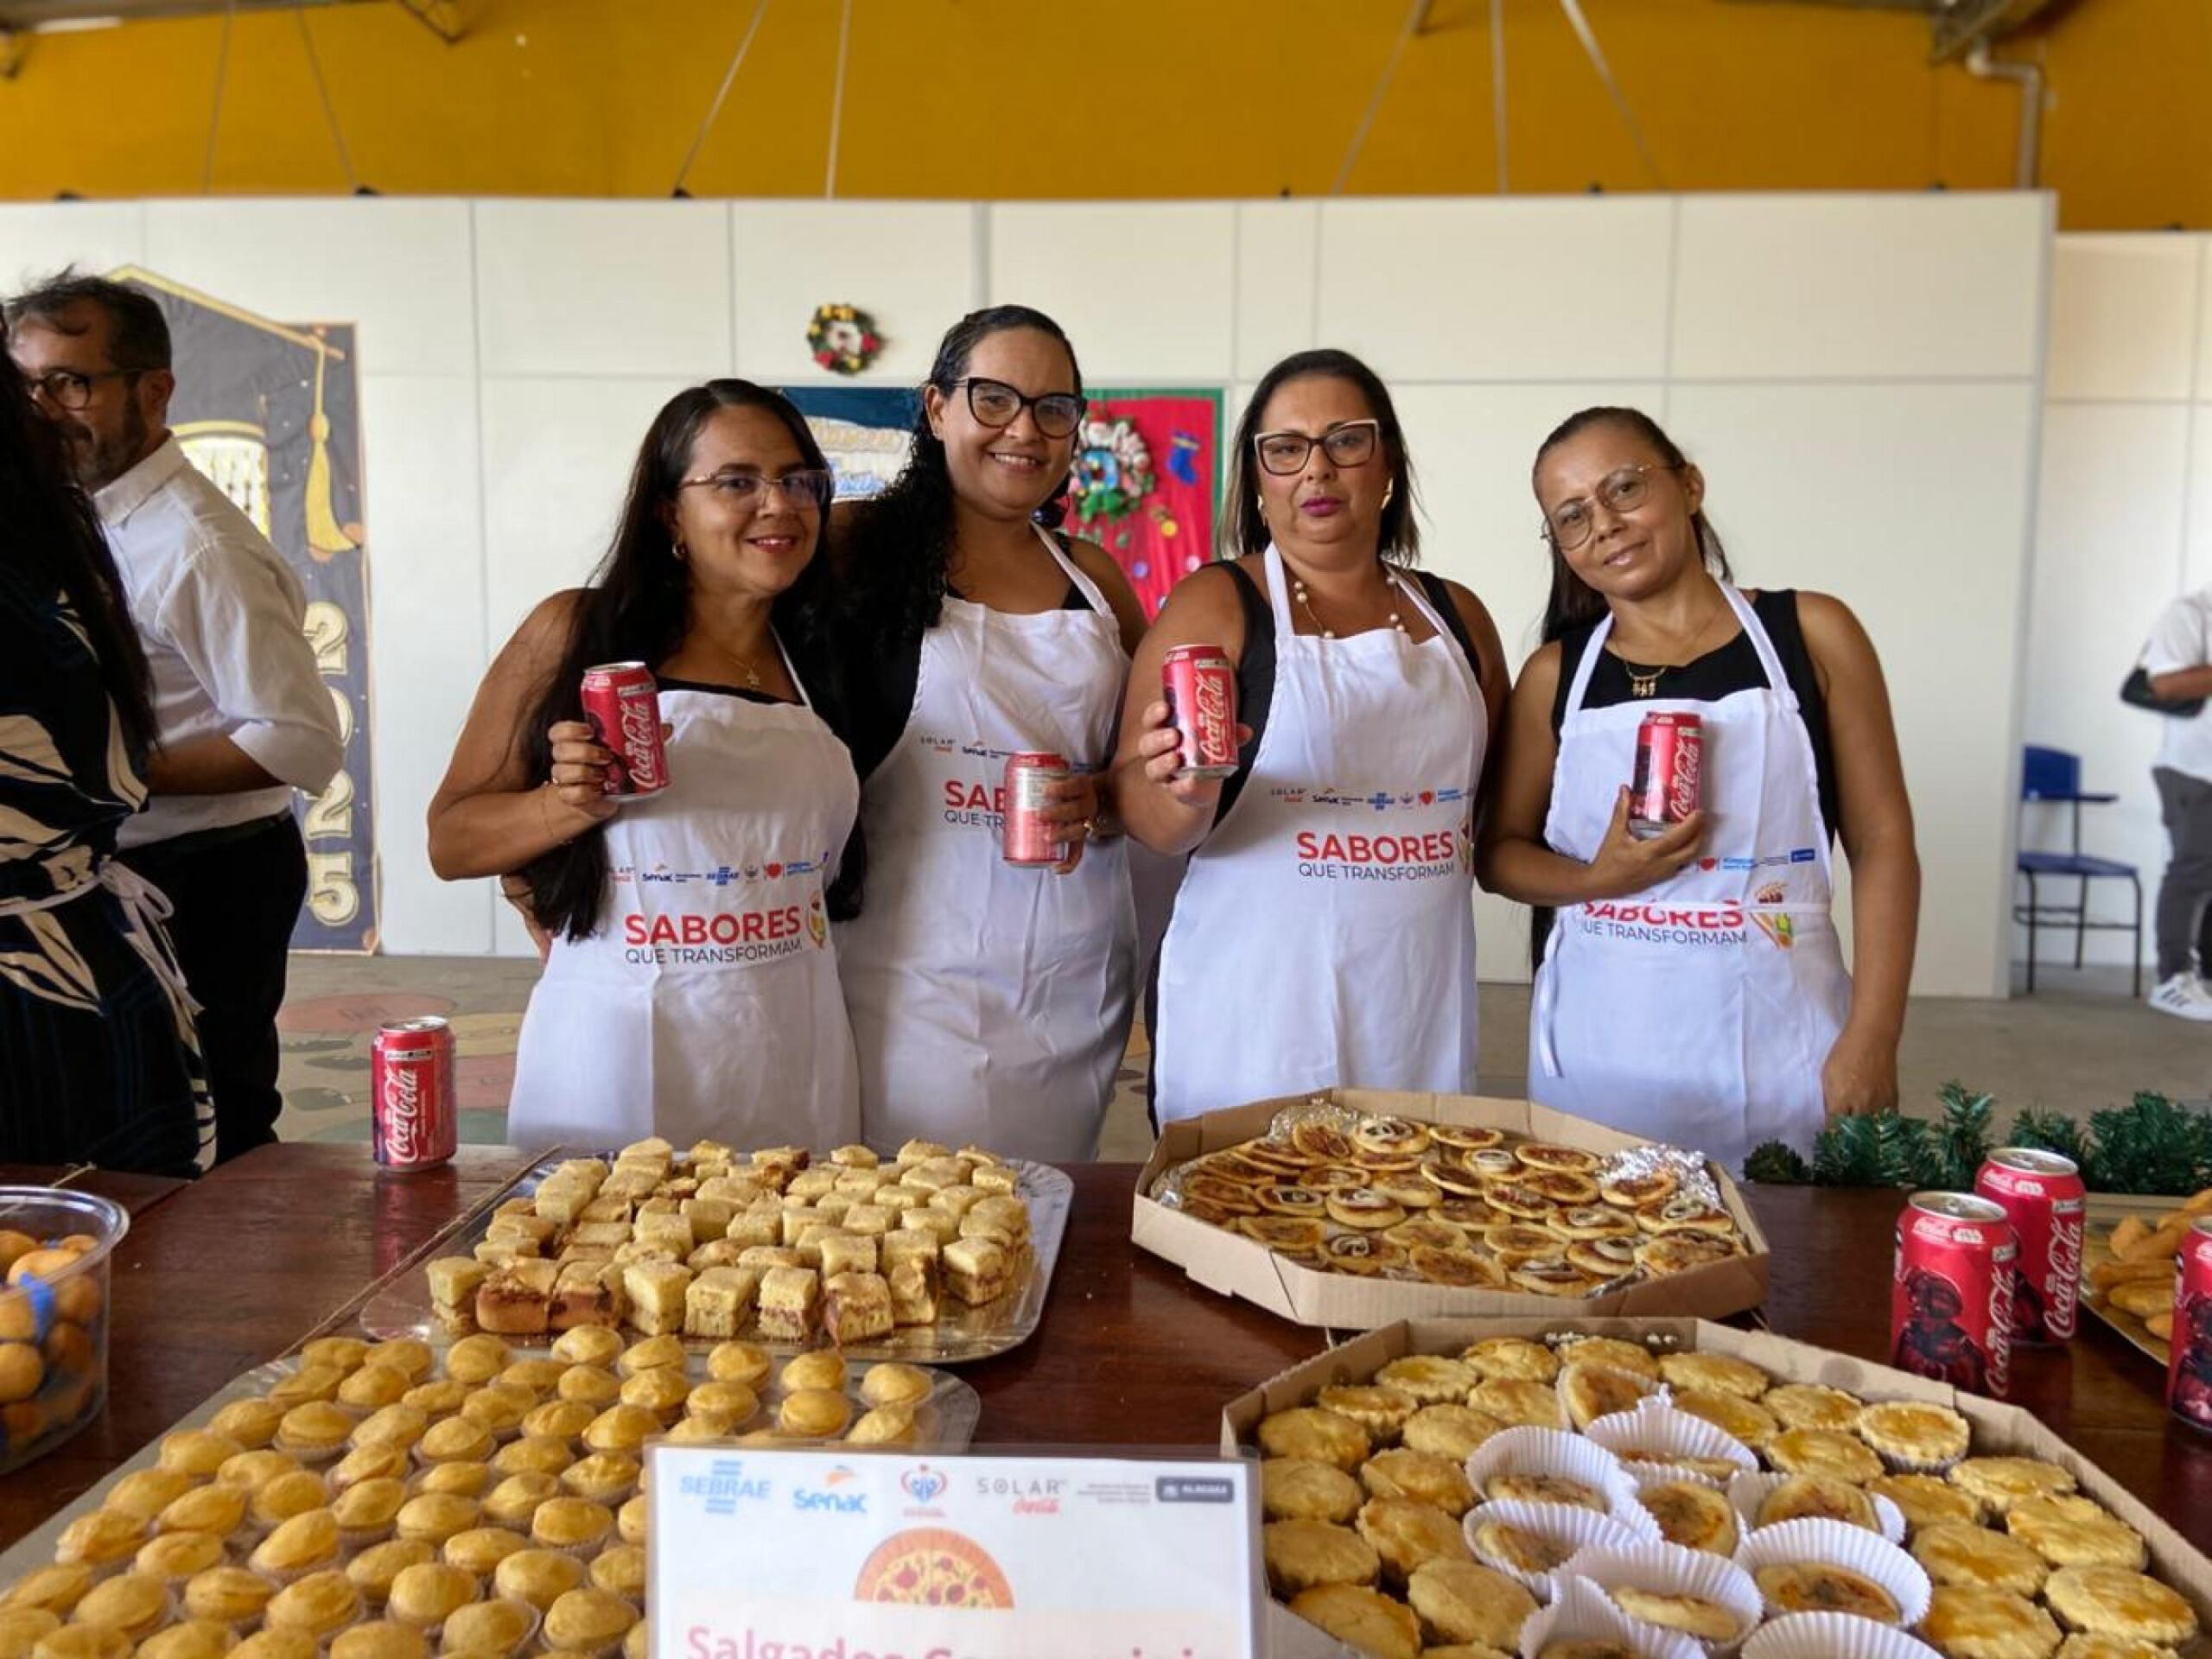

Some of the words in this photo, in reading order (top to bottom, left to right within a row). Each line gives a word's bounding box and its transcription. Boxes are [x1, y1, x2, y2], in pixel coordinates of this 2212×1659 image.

[944, 810, 982, 827] QUE
[1297, 832, 1454, 864] SABORES
[1299, 864, 1337, 879] QUE
[1343, 862, 1455, 881] TRANSFORMAM
[625, 906, 801, 945] SABORES
[625, 948, 666, 964] QUE
[670, 940, 803, 963] TRANSFORMAM
[680, 1476, 771, 1499] SEBRAE
[976, 1478, 1060, 1496] SOLAR
